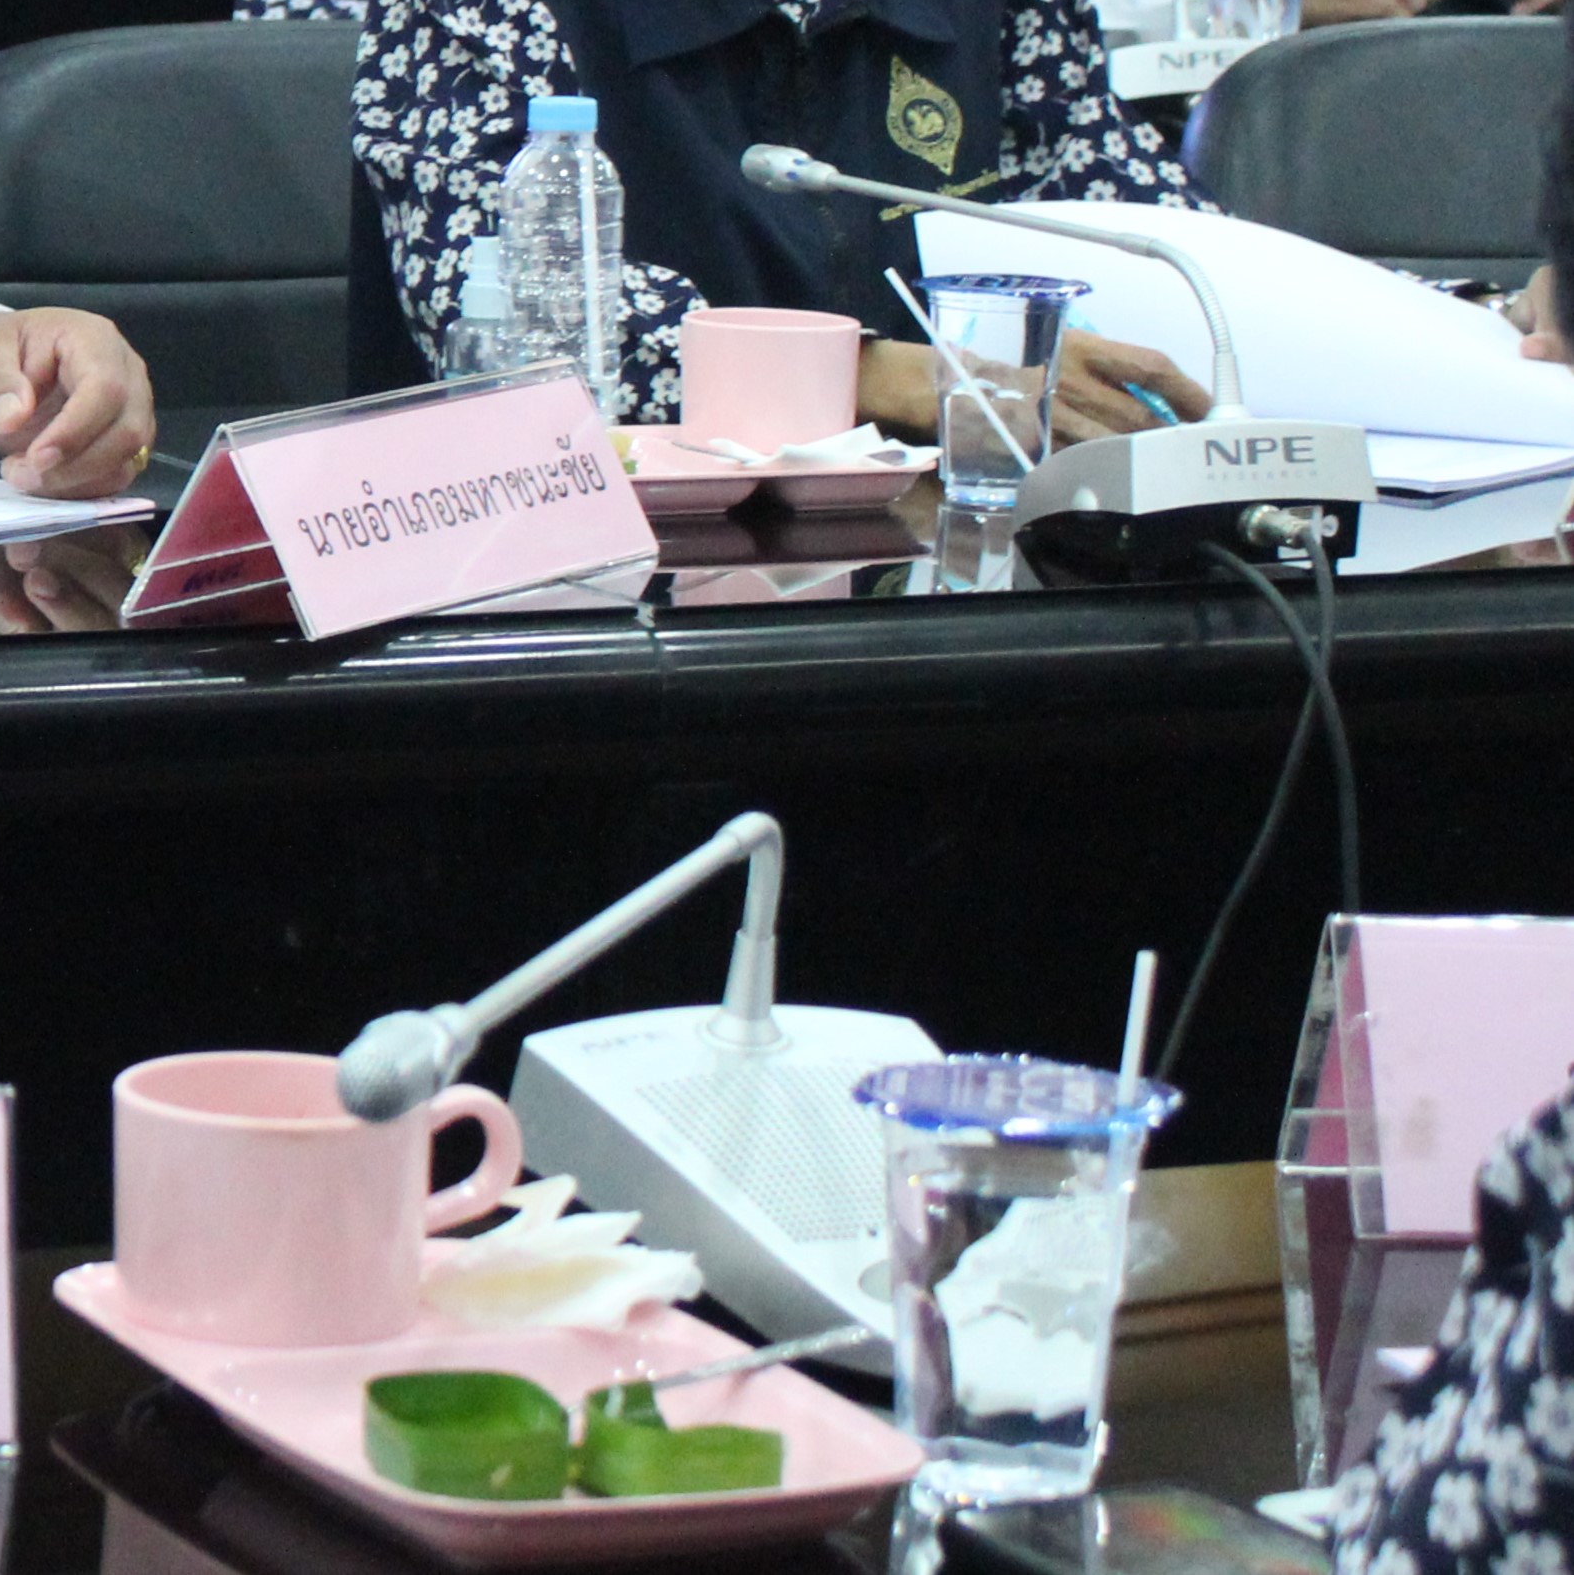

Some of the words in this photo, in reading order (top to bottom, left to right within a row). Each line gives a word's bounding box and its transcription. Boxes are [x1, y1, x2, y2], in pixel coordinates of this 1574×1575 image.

[1205, 436, 1315, 466] NPE
[298, 434, 607, 557] นายอำเภอมหาชนะชัย
